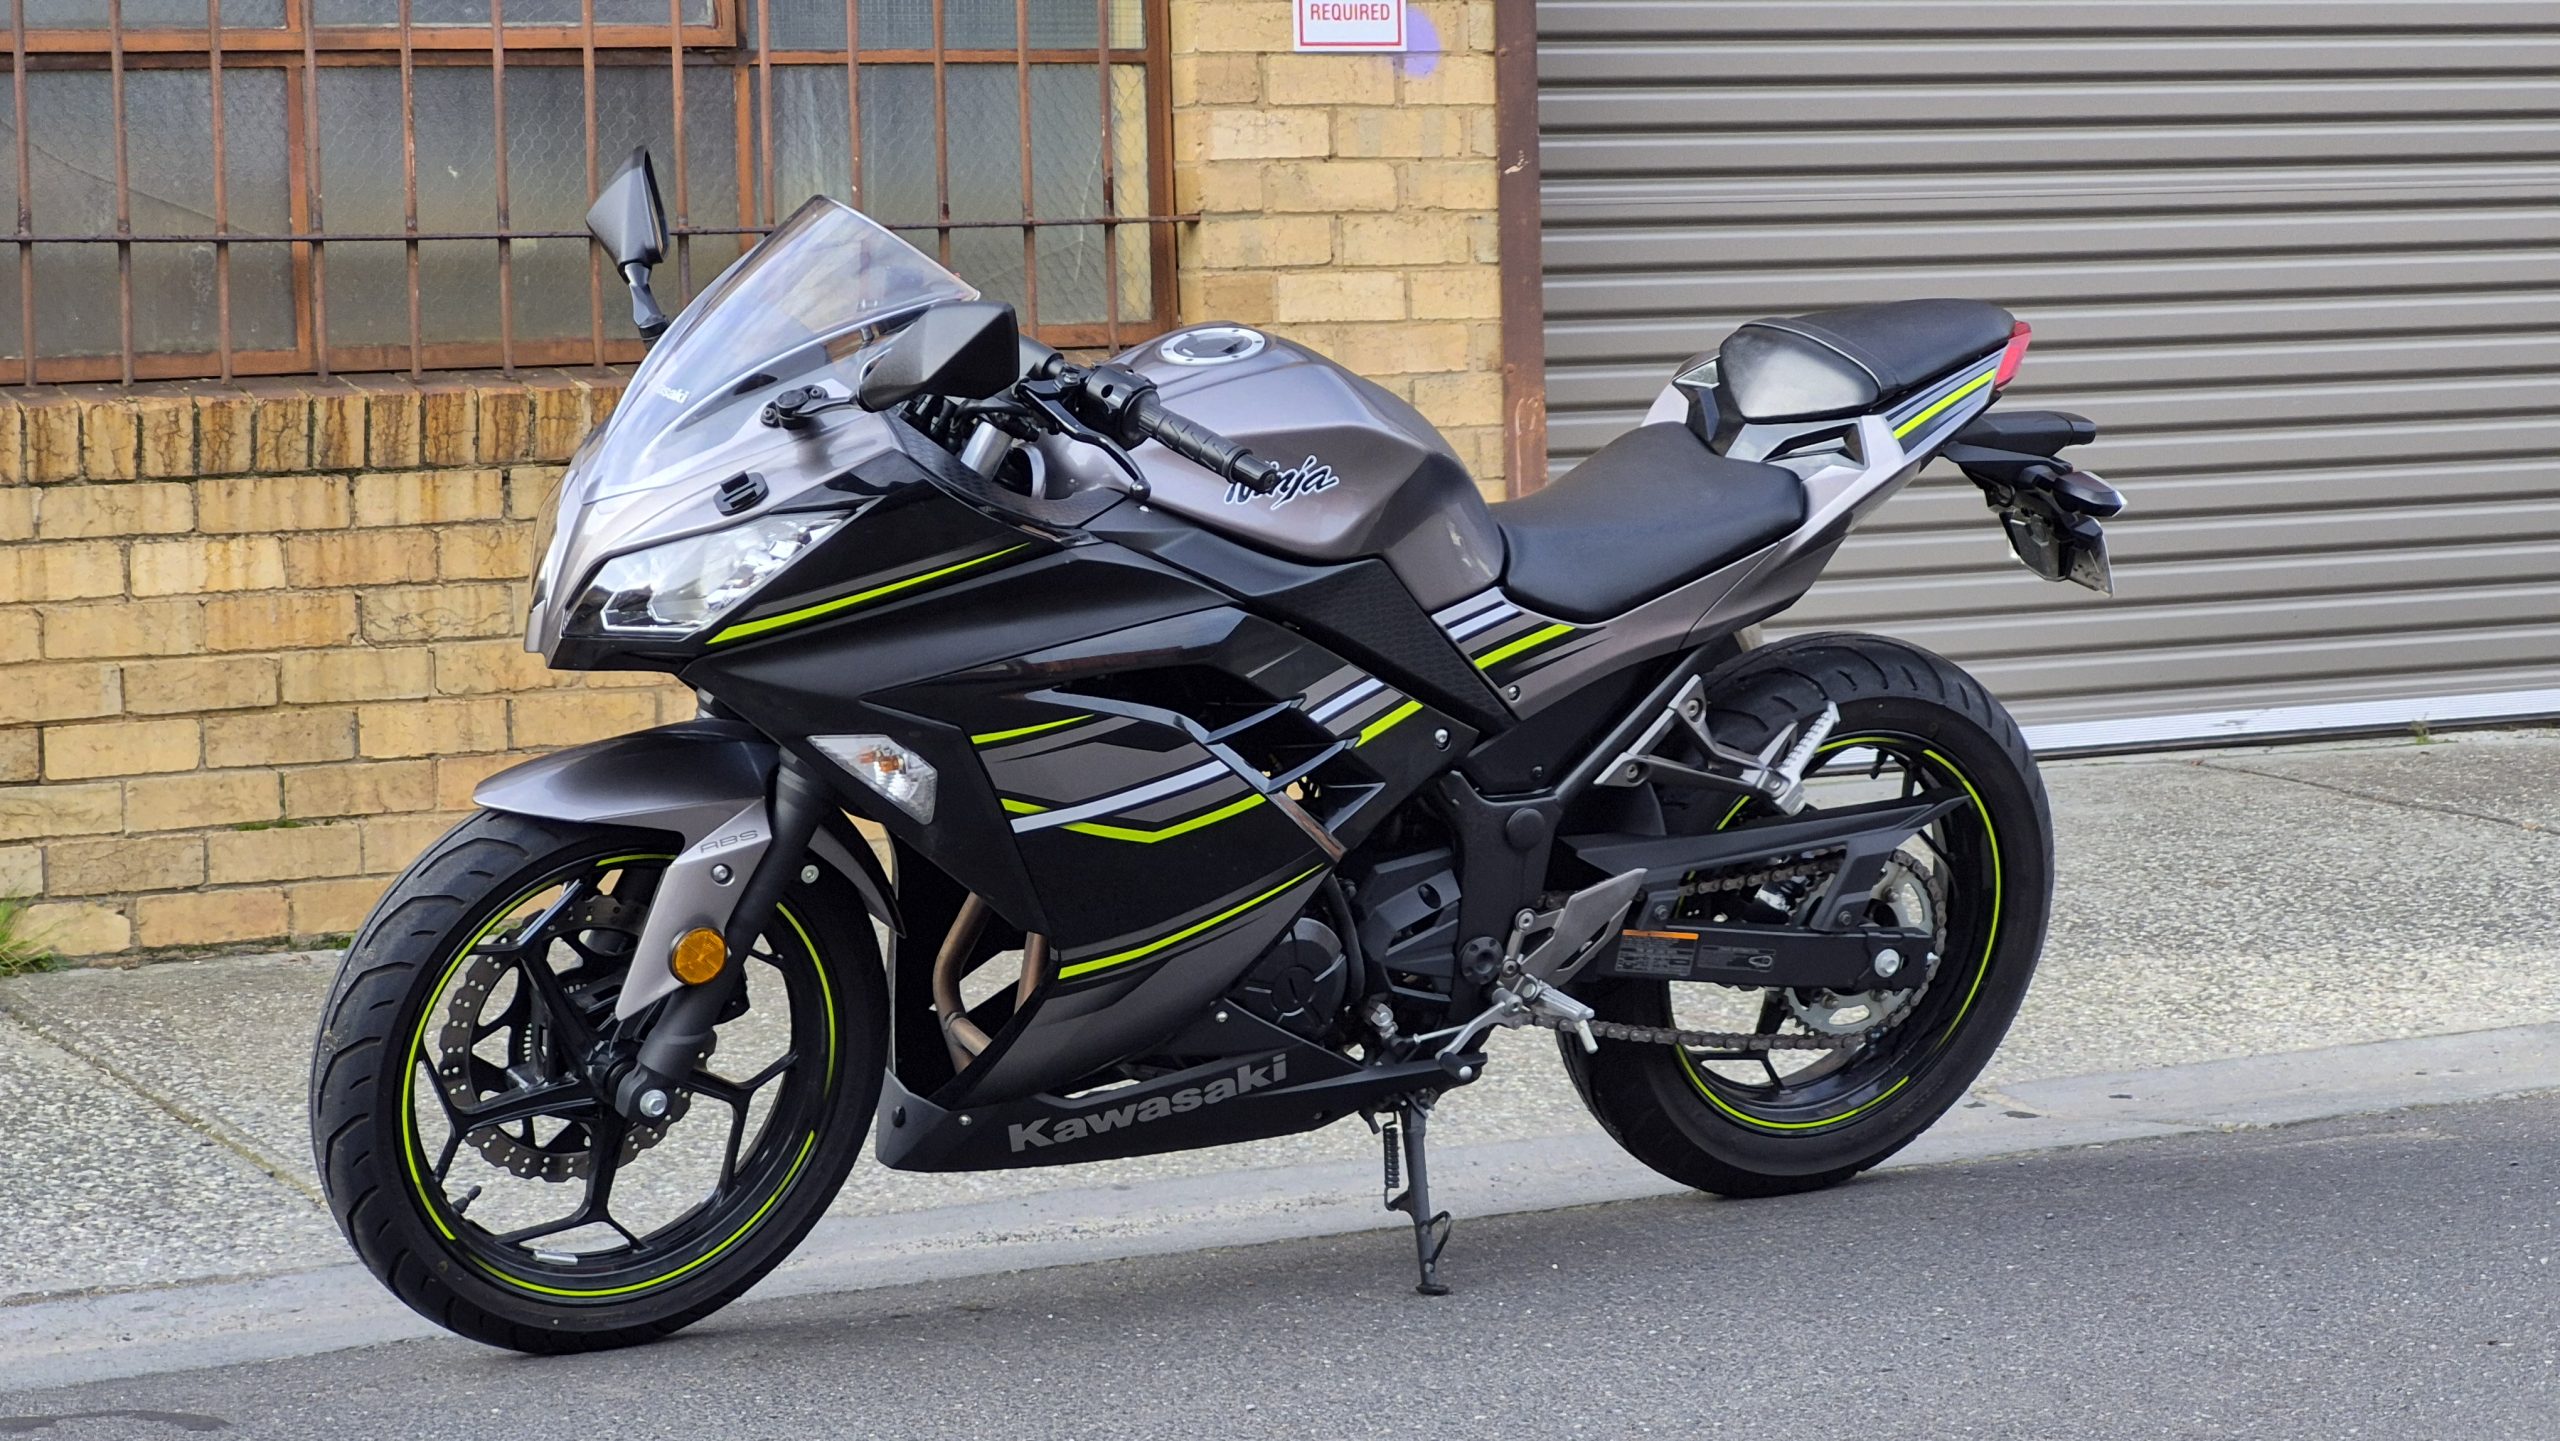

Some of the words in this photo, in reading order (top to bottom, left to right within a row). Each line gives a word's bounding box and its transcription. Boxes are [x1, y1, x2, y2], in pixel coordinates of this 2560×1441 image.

[1310, 3, 1390, 21] REQUIRED
[1225, 455, 1340, 510] nja
[701, 830, 758, 853] ABS
[1008, 1053, 1287, 1153] Kawasaki
